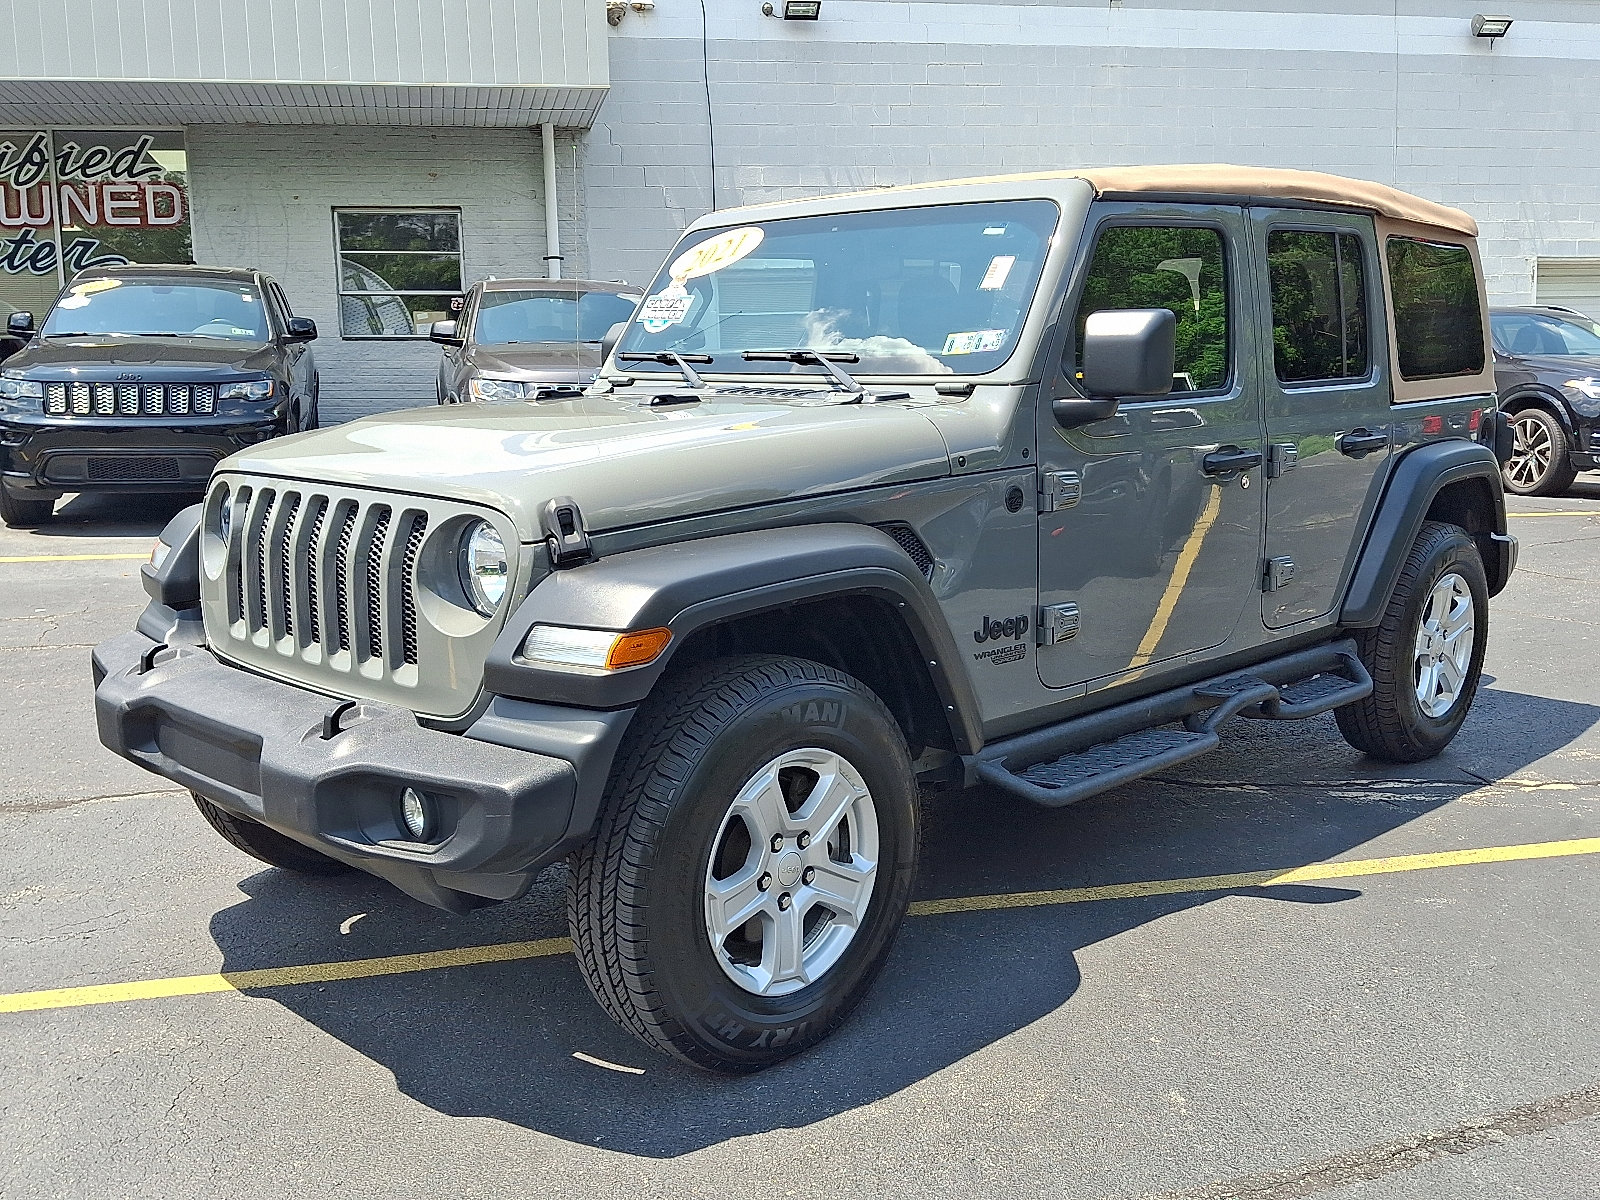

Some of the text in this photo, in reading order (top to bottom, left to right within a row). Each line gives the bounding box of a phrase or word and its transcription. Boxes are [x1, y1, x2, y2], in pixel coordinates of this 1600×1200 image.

[683, 233, 750, 273] 2021
[116, 372, 143, 381] Jeep
[973, 614, 1029, 643] Jeep
[973, 643, 1026, 660] WRANGLER
